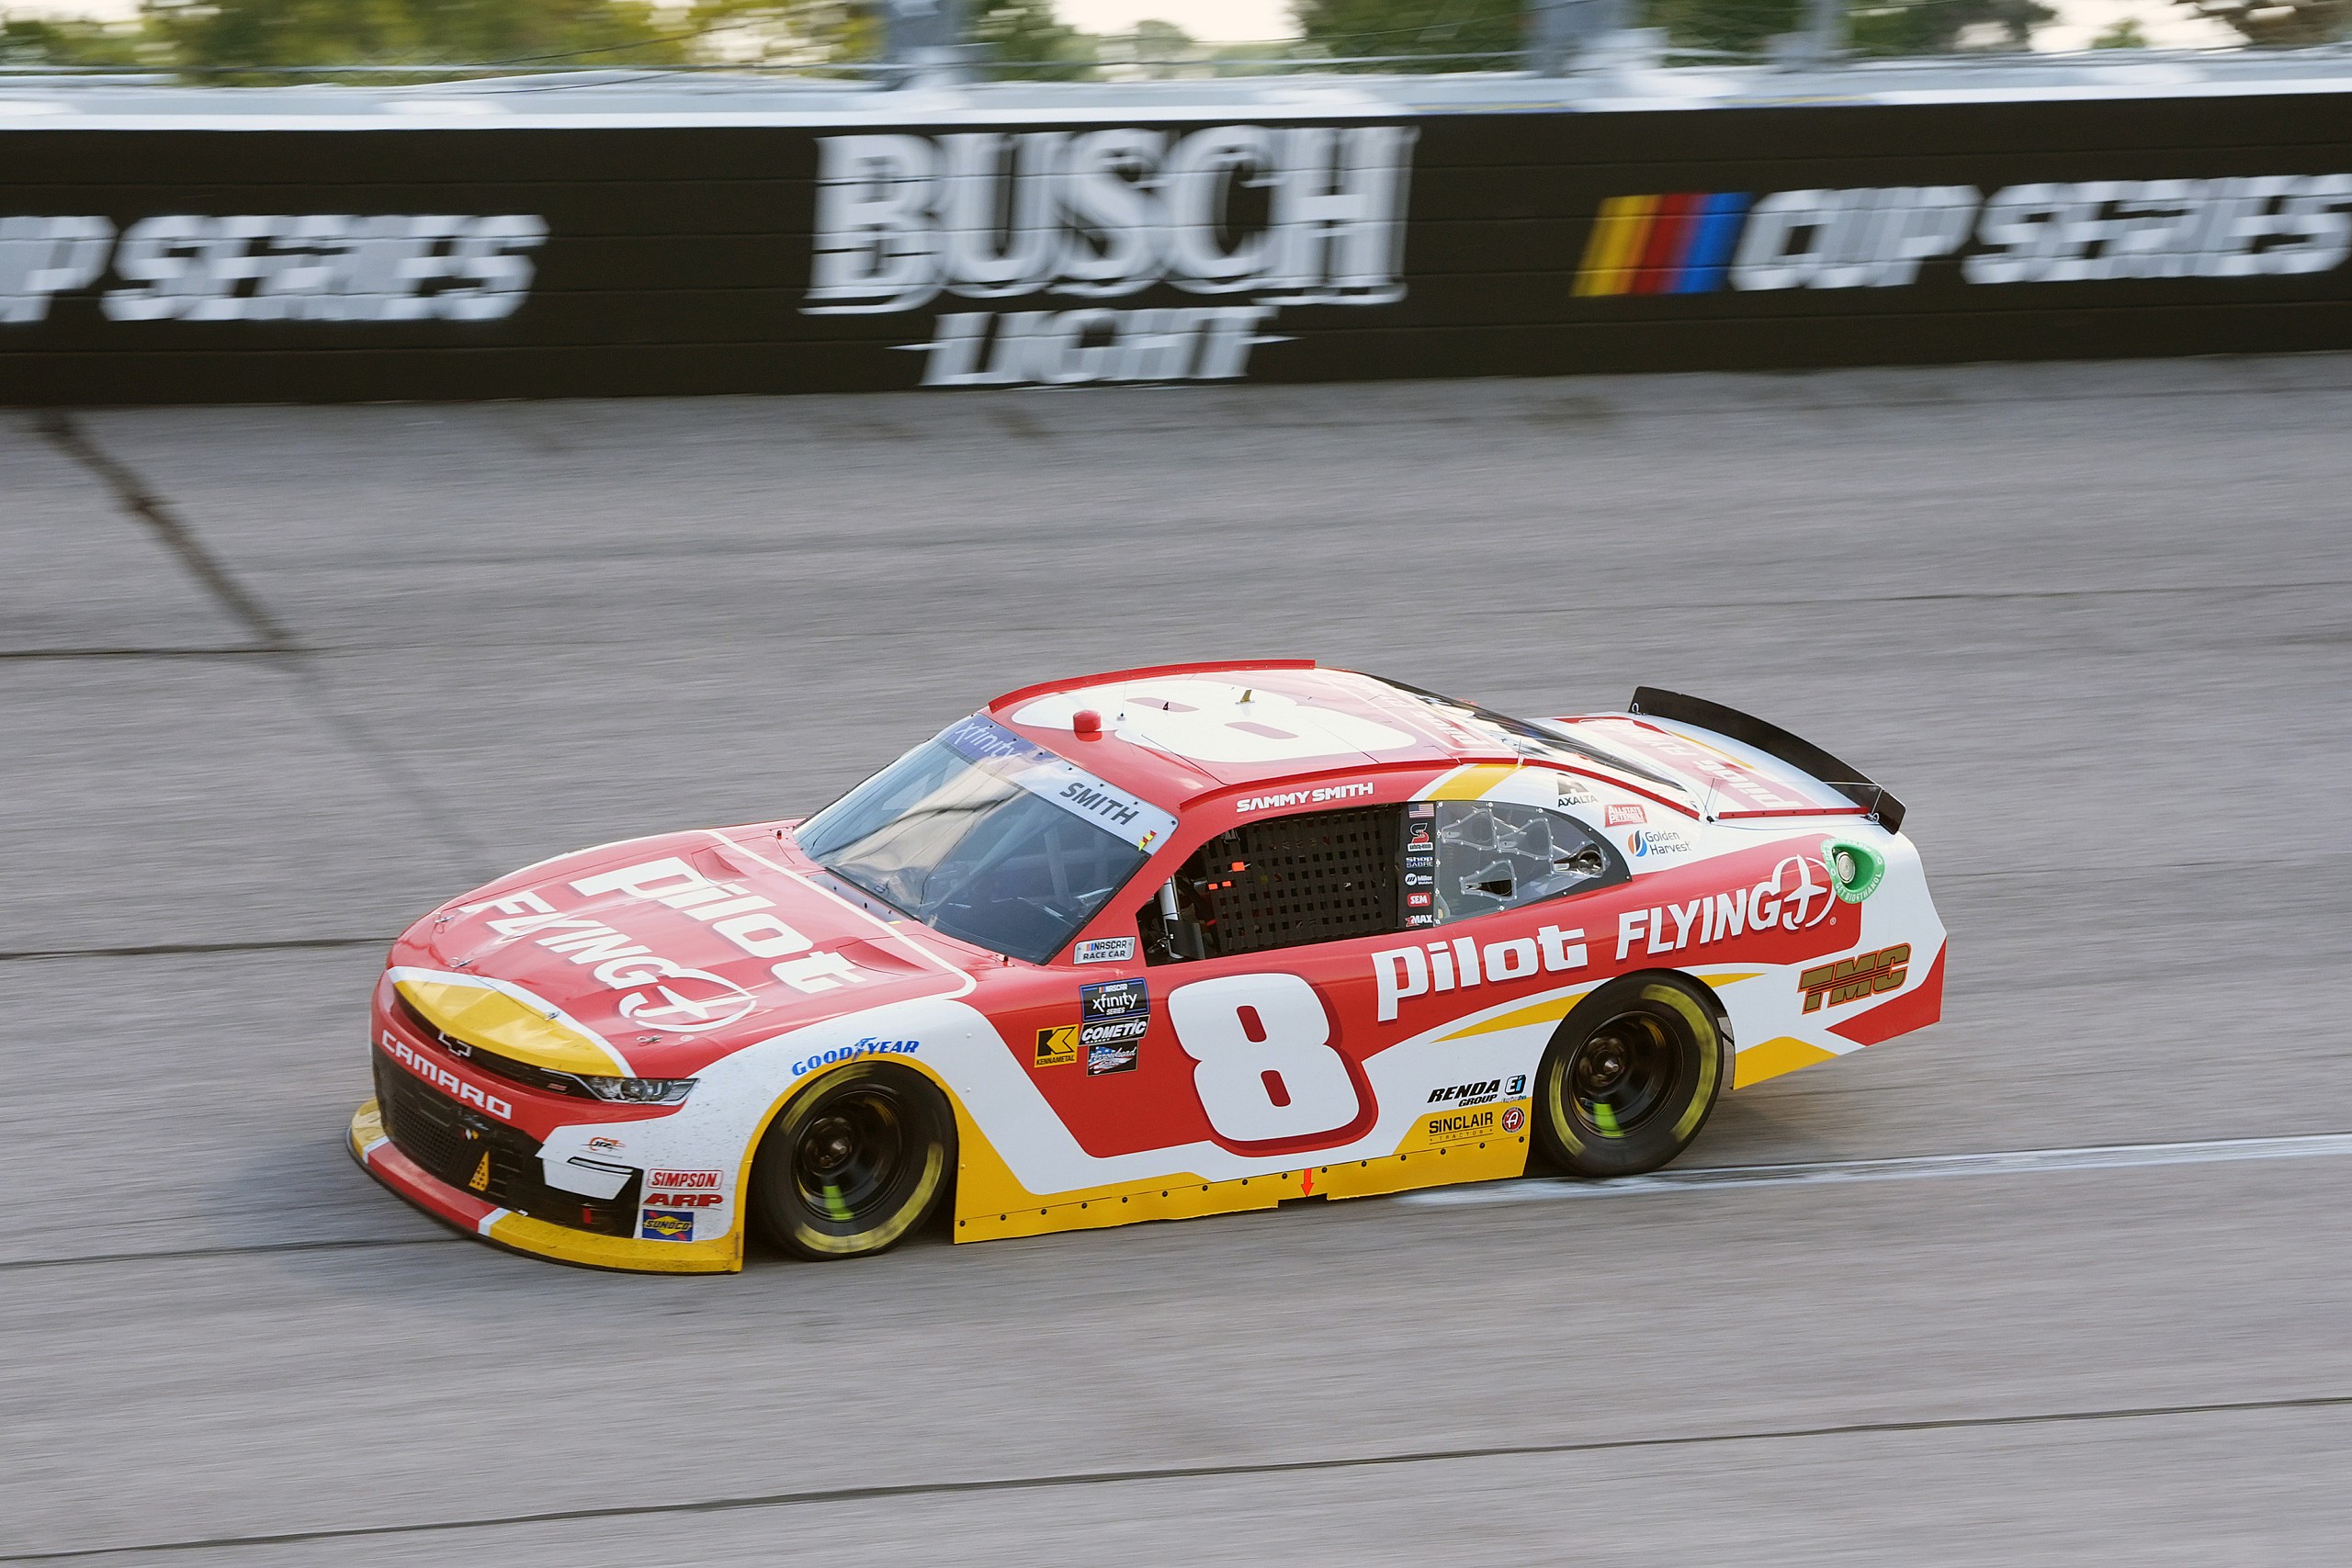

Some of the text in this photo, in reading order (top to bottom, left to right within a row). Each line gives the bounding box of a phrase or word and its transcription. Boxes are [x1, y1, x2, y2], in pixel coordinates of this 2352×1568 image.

[799, 124, 1420, 313] BUSCH
[1729, 186, 1983, 291] CUP
[921, 305, 1280, 386] LIGHT
[1059, 782, 1139, 825] SMITH
[1237, 783, 1374, 813] SAMMY SMITH
[1557, 795, 1600, 807] AXALTA
[1645, 830, 1679, 841] Golden
[1650, 840, 1690, 855] Harvest
[1845, 873, 1882, 902] BIOETHANOL
[1410, 895, 1428, 905] SEM
[1615, 880, 1782, 960] FLYING
[458, 890, 681, 990] FLYING
[1093, 940, 1127, 951] NASCAR
[1083, 950, 1125, 960] RACE CAR
[1798, 942, 1911, 1014] TMC
[1105, 983, 1128, 993] NASCAR
[1092, 993, 1137, 1012] xfinity
[1106, 1007, 1125, 1015] SERIES
[1081, 1021, 1147, 1042] COMETIC
[1036, 1055, 1075, 1066] KENNAMETAL
[1168, 973, 1360, 1142] 8
[381, 1030, 512, 1120] CAMARO
[1427, 1079, 1501, 1103] RENDA
[1459, 1094, 1498, 1107] GROUP
[1430, 1111, 1493, 1134] SINCLAIR
[1439, 1130, 1484, 1140] TRACTOR
[651, 1172, 718, 1187] SIMPSON
[643, 1193, 723, 1206] ARP
[645, 1220, 691, 1230] SUNOCO
